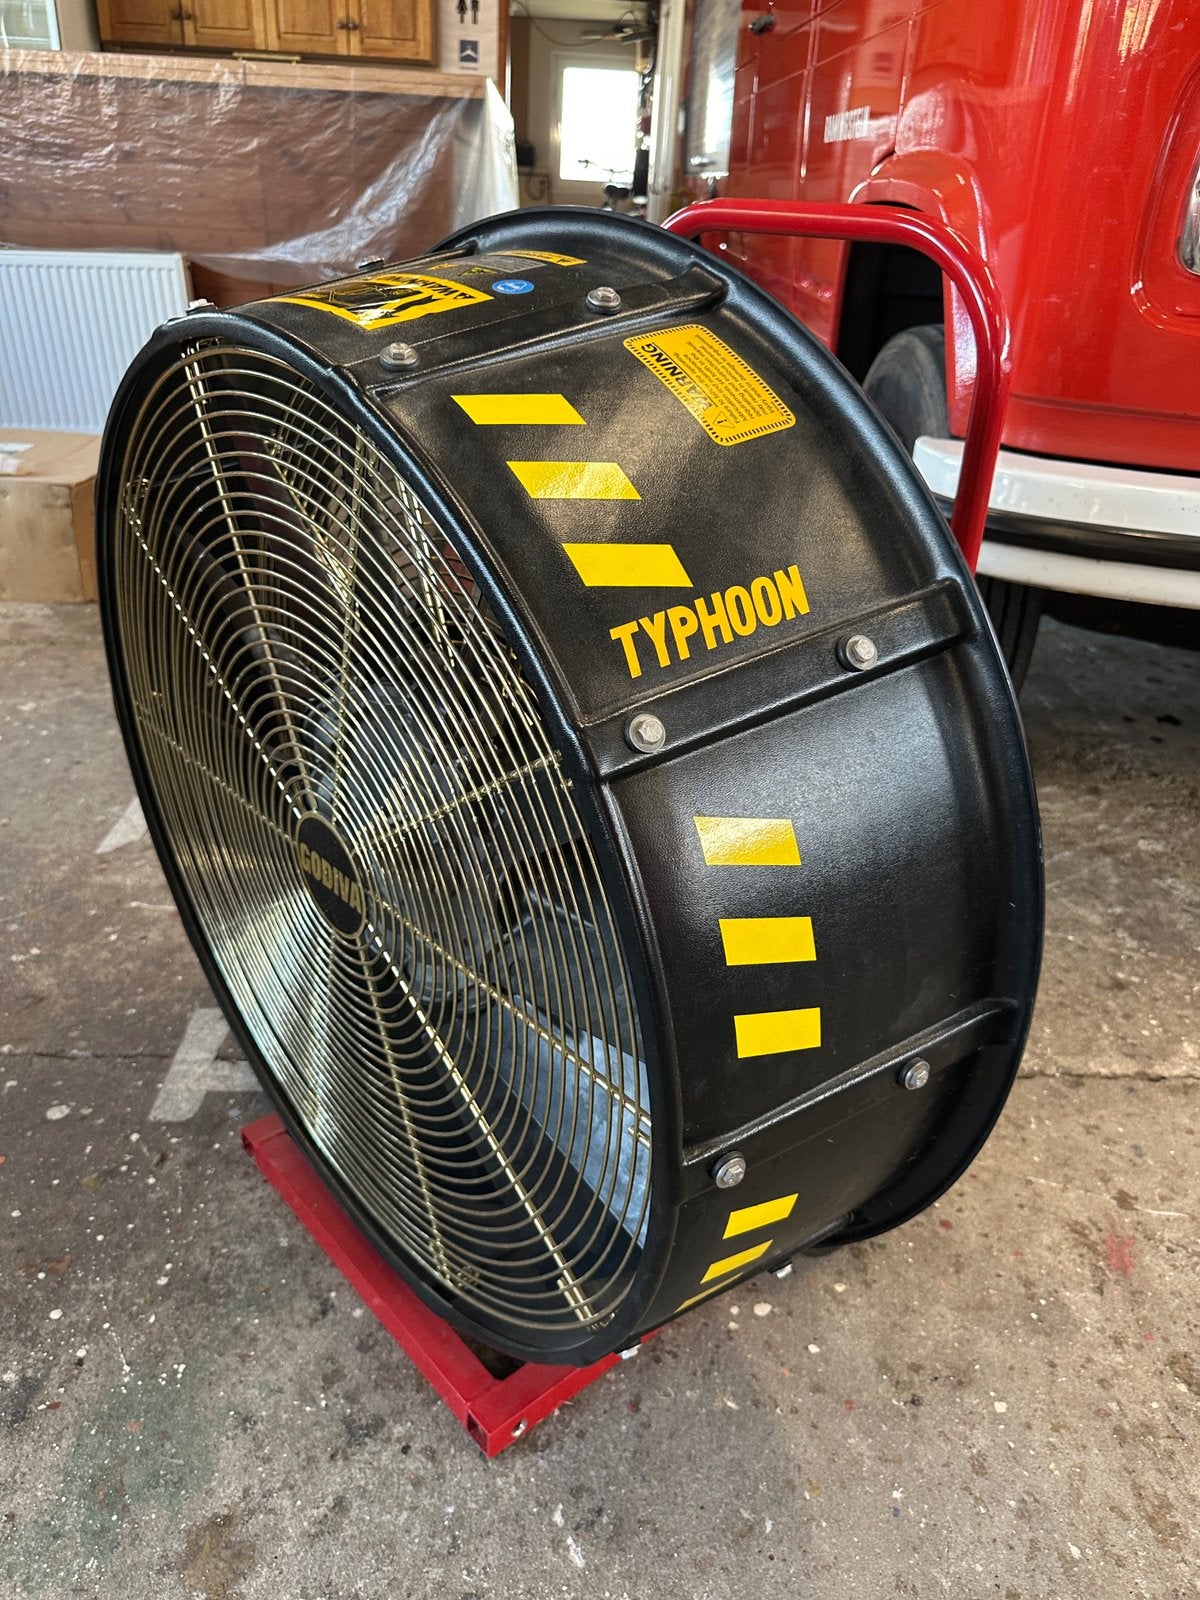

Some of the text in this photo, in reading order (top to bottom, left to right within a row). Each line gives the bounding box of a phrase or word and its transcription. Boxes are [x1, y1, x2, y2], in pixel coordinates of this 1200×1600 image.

[641, 343, 714, 411] WARNING
[694, 374, 705, 383] the
[711, 383, 724, 393] and
[727, 381, 740, 392] and
[609, 564, 810, 679] TYPHOON
